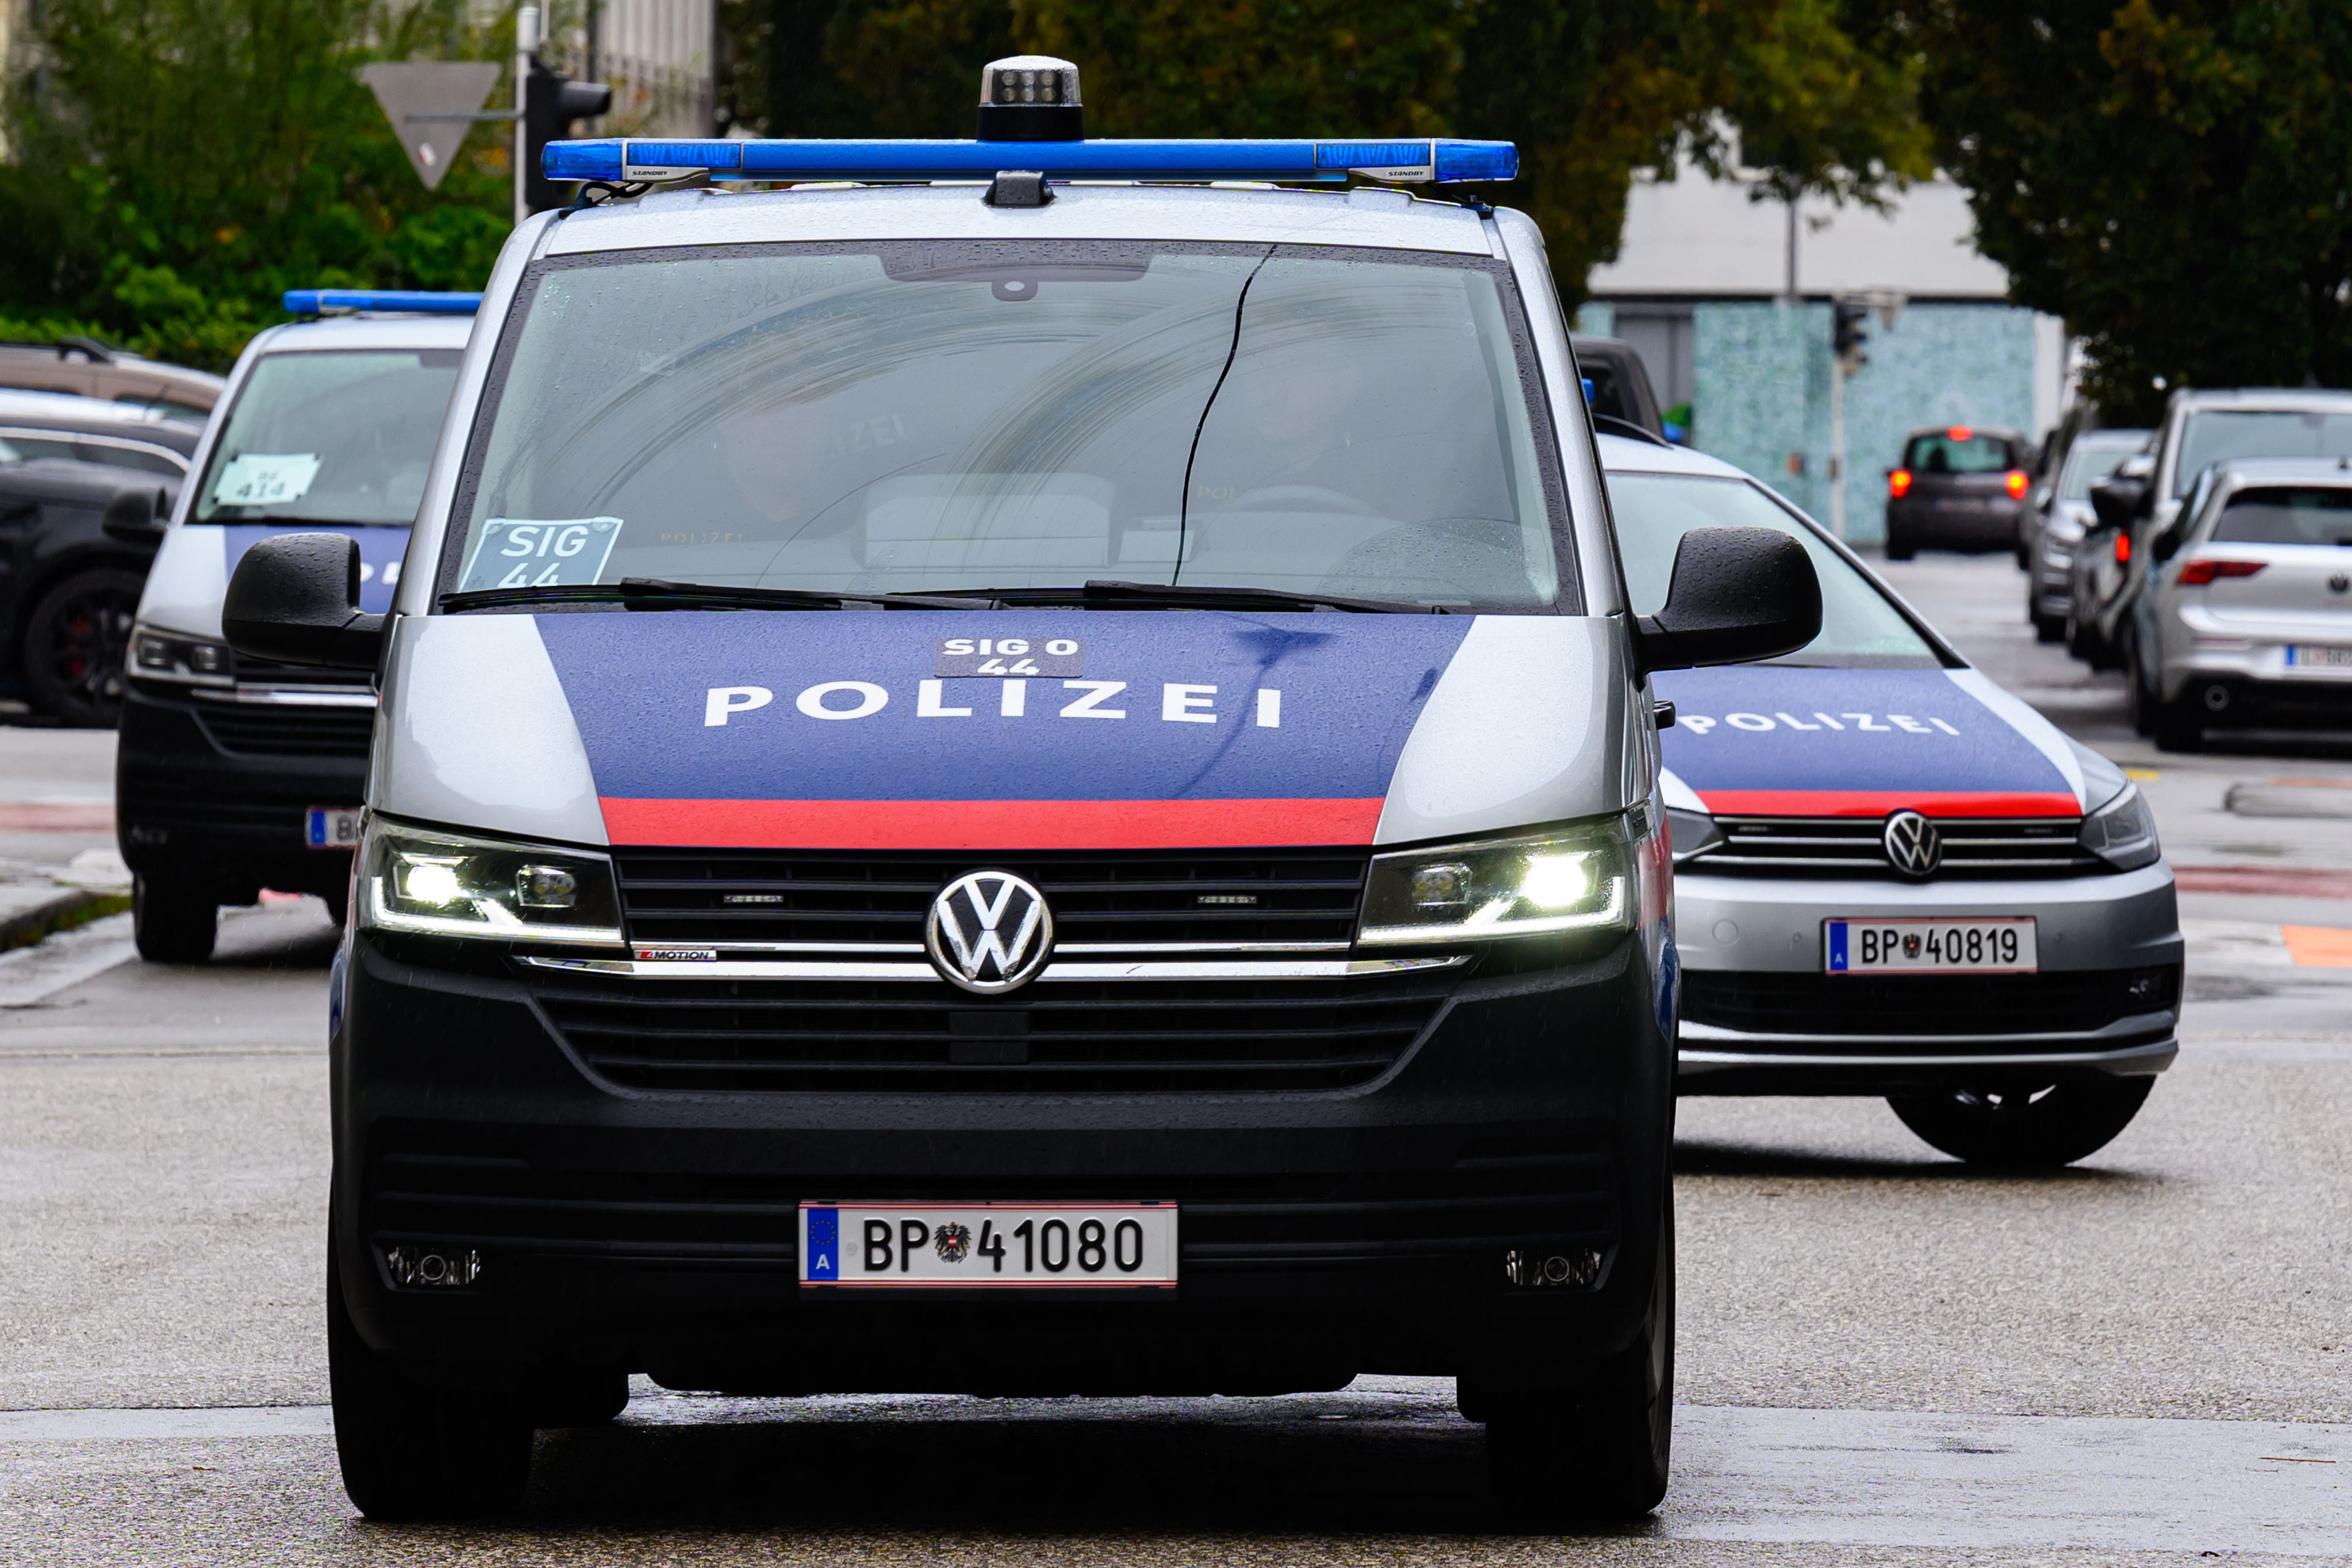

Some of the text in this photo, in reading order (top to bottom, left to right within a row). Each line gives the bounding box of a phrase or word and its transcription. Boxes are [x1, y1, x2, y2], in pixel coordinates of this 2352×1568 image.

[500, 525, 590, 558] SIG
[497, 562, 560, 586] 44
[942, 638, 1030, 656] SIG
[977, 658, 1040, 676] 44
[704, 679, 1281, 727] POLIZEI
[1677, 712, 1961, 735] POLIZEI
[1861, 928, 2018, 964] BP 40819
[1834, 952, 1843, 964] A
[863, 1218, 1144, 1272] BP 41080
[816, 1253, 830, 1270] A
